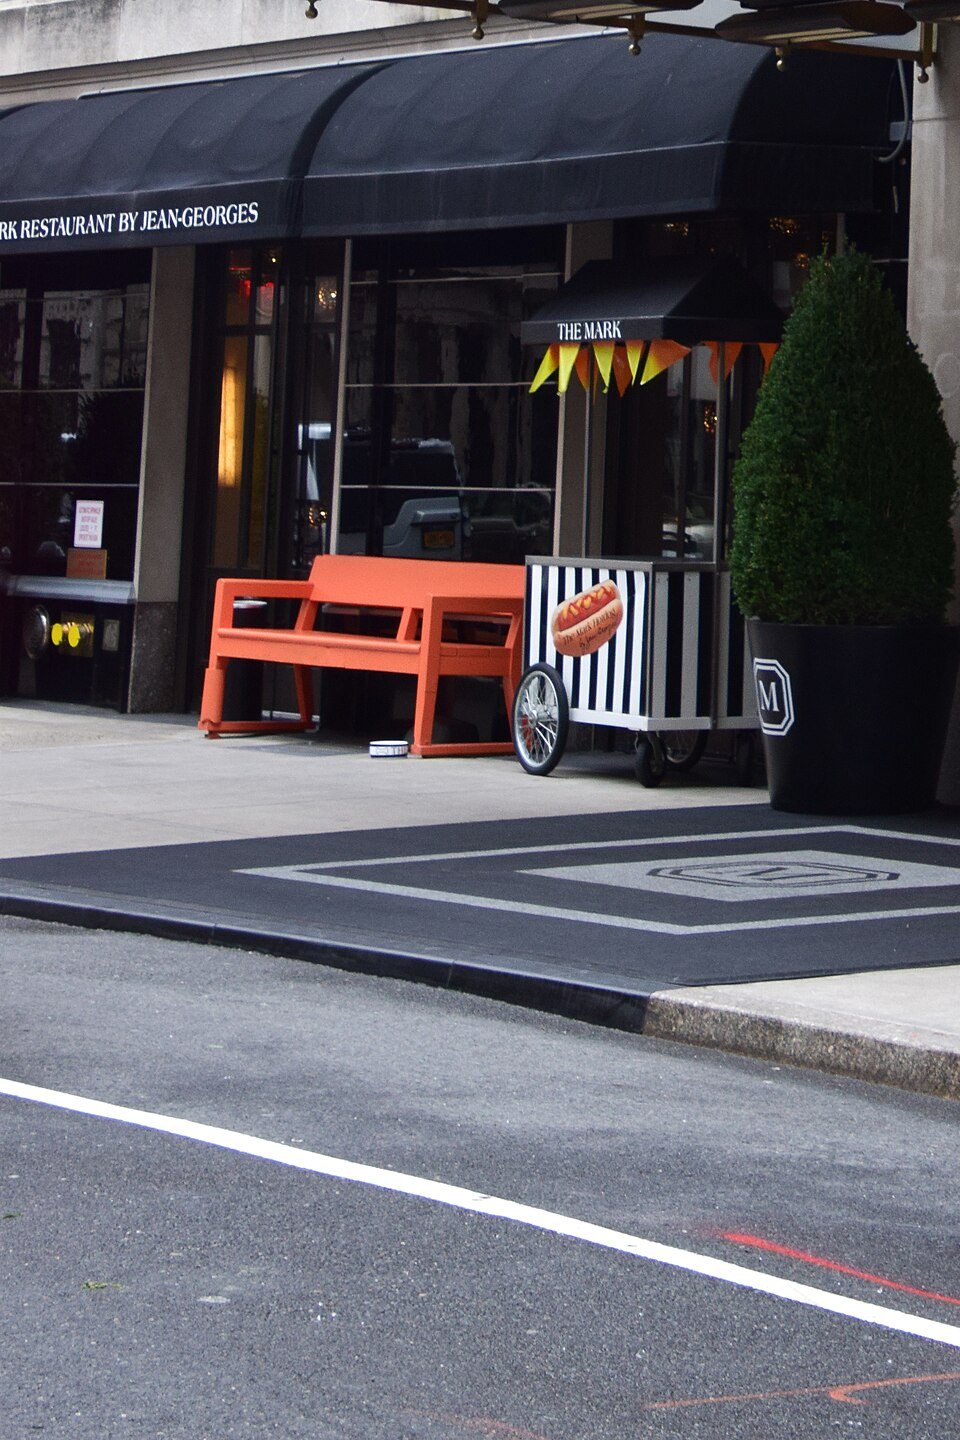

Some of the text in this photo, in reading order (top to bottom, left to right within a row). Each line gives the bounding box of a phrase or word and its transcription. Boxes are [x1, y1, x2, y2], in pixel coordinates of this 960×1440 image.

[20, 212, 116, 239] RESTAURANT
[118, 211, 138, 232] BY
[139, 201, 259, 231] JEAN-GEORGES
[557, 320, 622, 340] THE MARK
[758, 679, 780, 712] M
